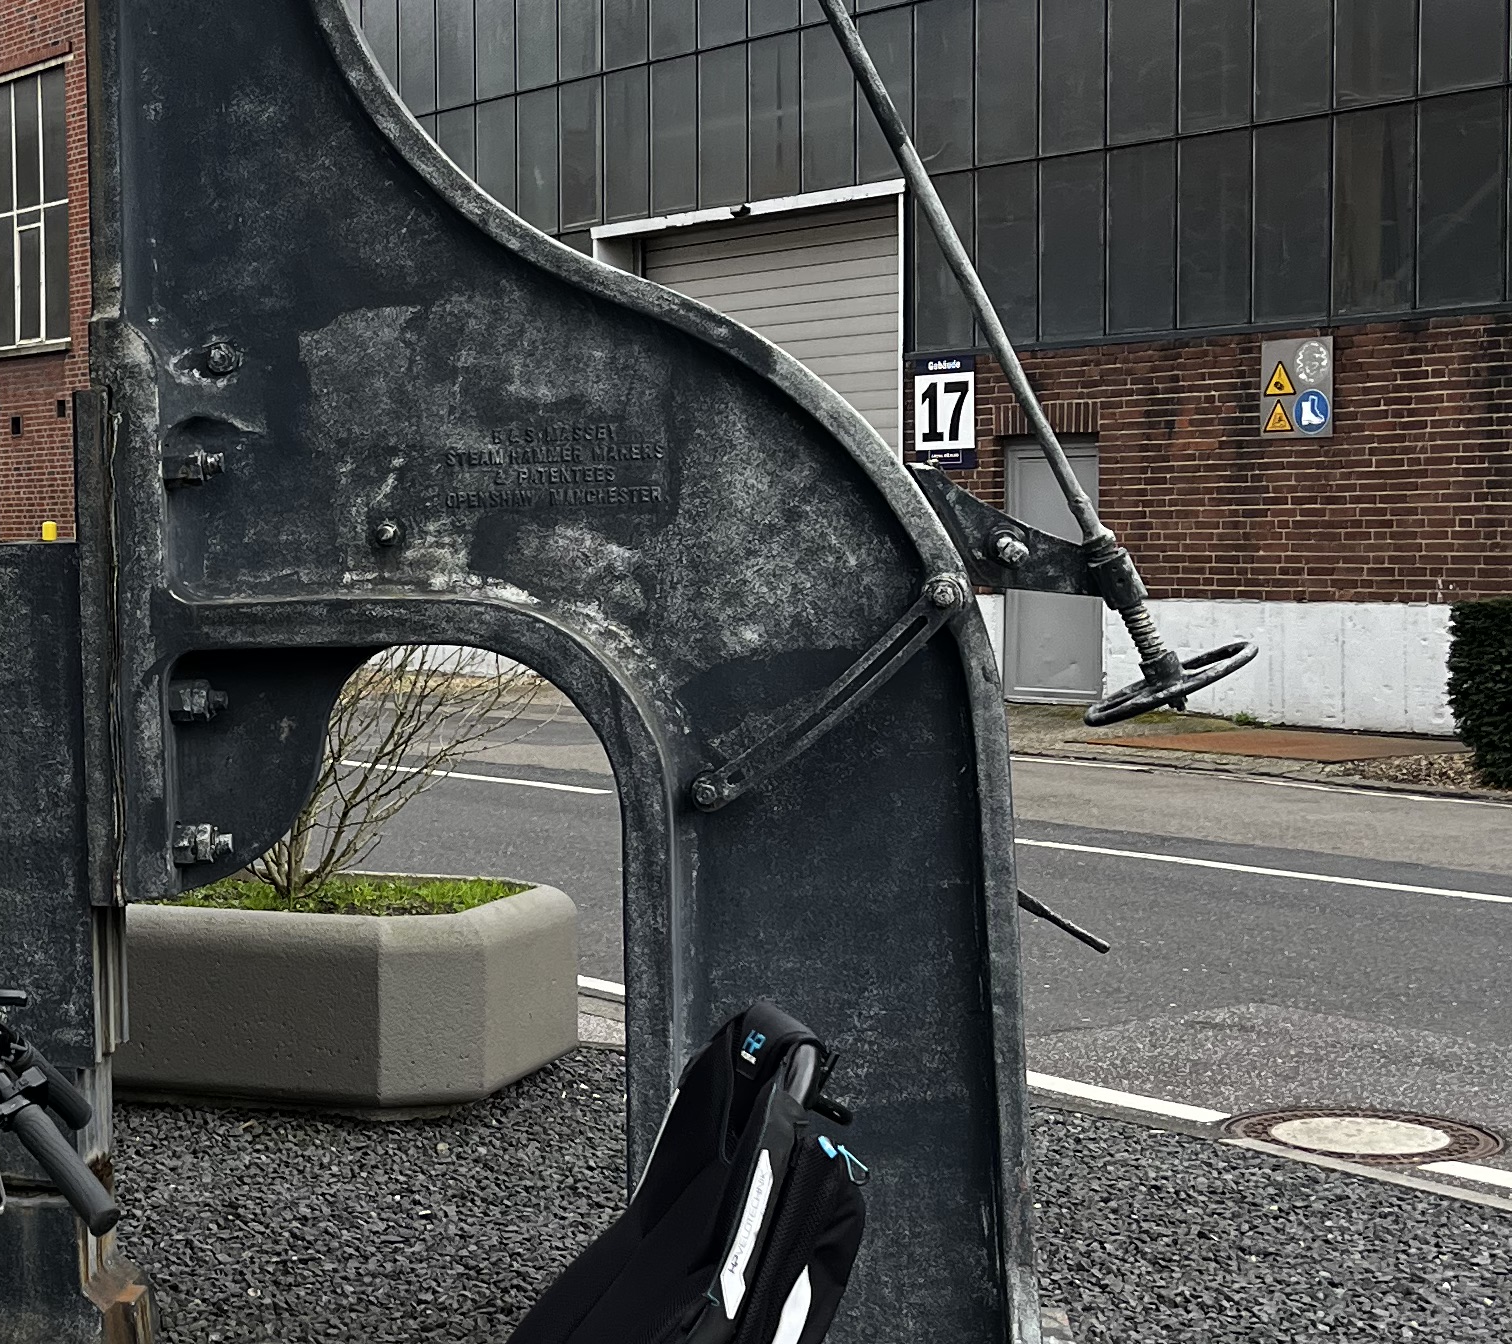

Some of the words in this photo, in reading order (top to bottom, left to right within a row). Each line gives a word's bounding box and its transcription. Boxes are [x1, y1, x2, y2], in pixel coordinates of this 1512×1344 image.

[921, 380, 969, 443] 17
[545, 423, 619, 443] MASSEY
[445, 448, 504, 467] STEAM
[509, 445, 584, 465] HAMMER
[591, 443, 664, 462] MAKERS
[518, 465, 616, 485] PATENTEES
[445, 490, 538, 508] OPENSHAW
